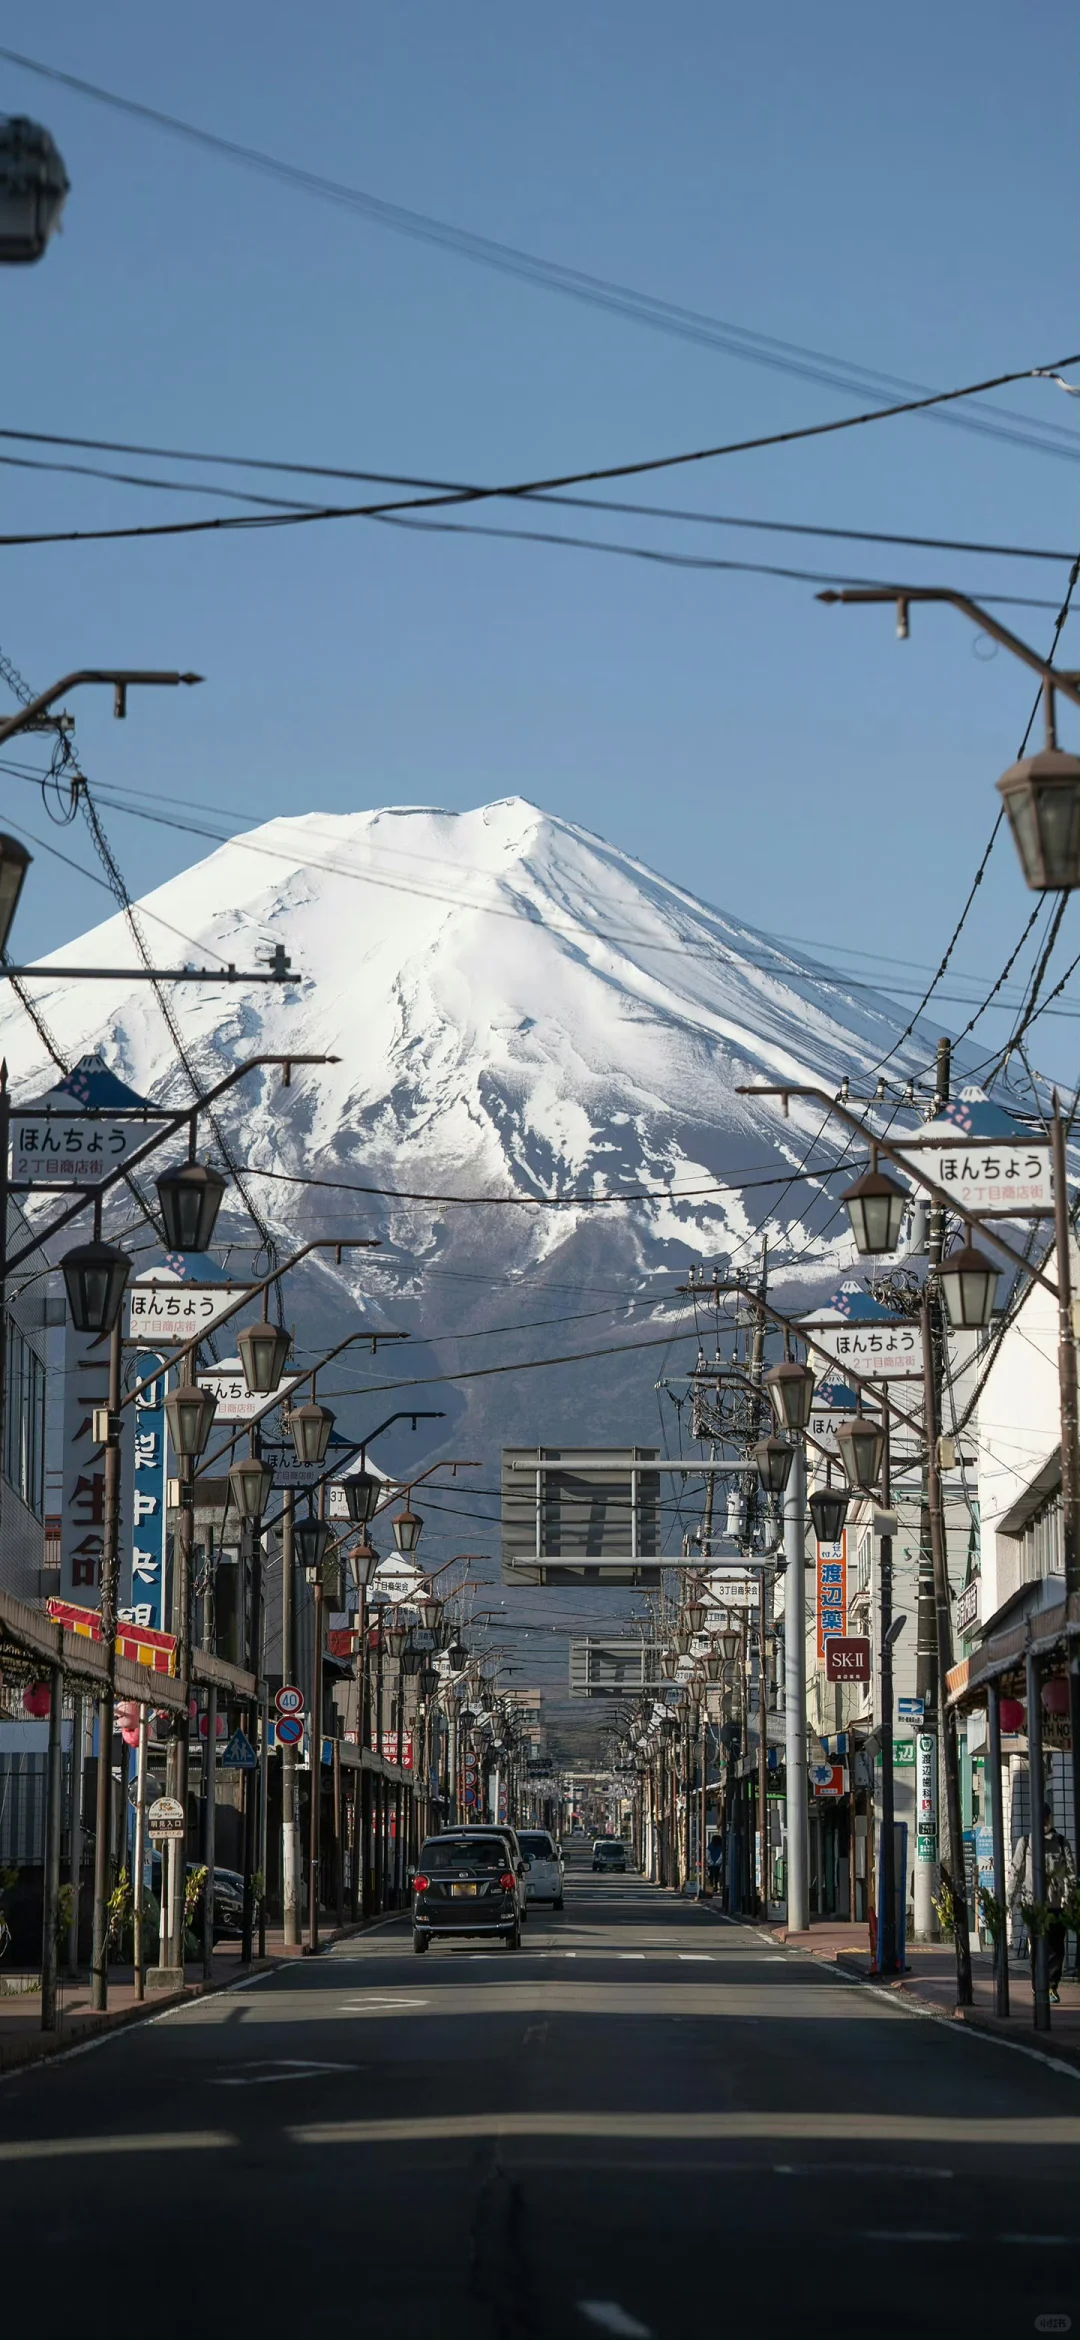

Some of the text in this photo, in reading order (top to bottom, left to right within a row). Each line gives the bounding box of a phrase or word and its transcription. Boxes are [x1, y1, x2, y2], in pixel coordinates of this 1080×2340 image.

[20, 1127, 126, 1154] ほんちょう
[940, 1154, 1042, 1180] ほんちょう
[131, 1296, 214, 1317] ほんちょう
[836, 1332, 915, 1354] ほんちょう
[218, 1403, 256, 1413] 目商店街
[265, 1472, 314, 1480] 丁目商店街
[282, 1694, 298, 1707] 40
